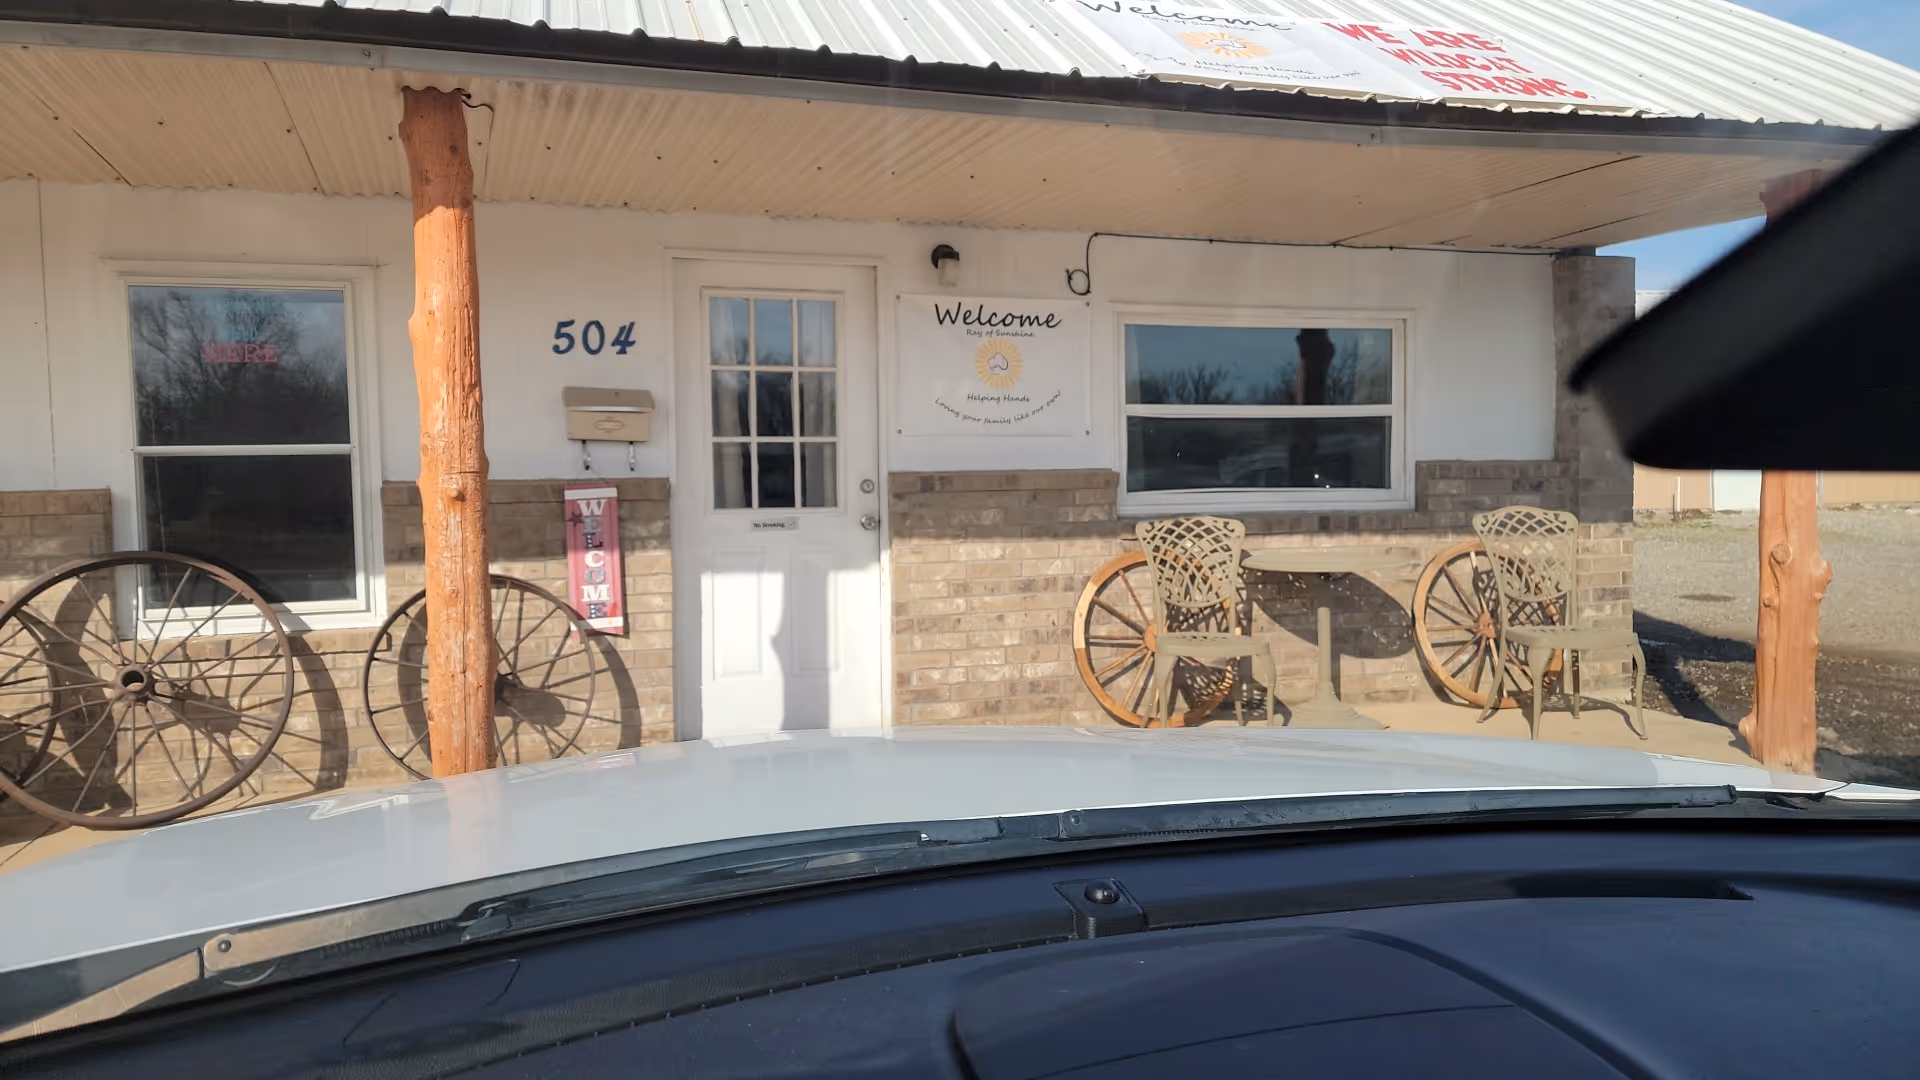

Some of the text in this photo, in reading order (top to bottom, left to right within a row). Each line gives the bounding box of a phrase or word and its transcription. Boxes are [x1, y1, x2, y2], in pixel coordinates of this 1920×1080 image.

[1076, 0, 1292, 30] Welcome
[1321, 22, 1506, 53] WE ARE
[1377, 47, 1534, 74] WILDCAT
[935, 301, 1063, 328] Welcome
[552, 319, 636, 356] 504
[966, 328, 1036, 338] Ray of Sunshine
[934, 390, 1063, 426] Loving your family like our own!
[966, 393, 1032, 404] Helping Hands
[577, 499, 610, 619] WELCOME
